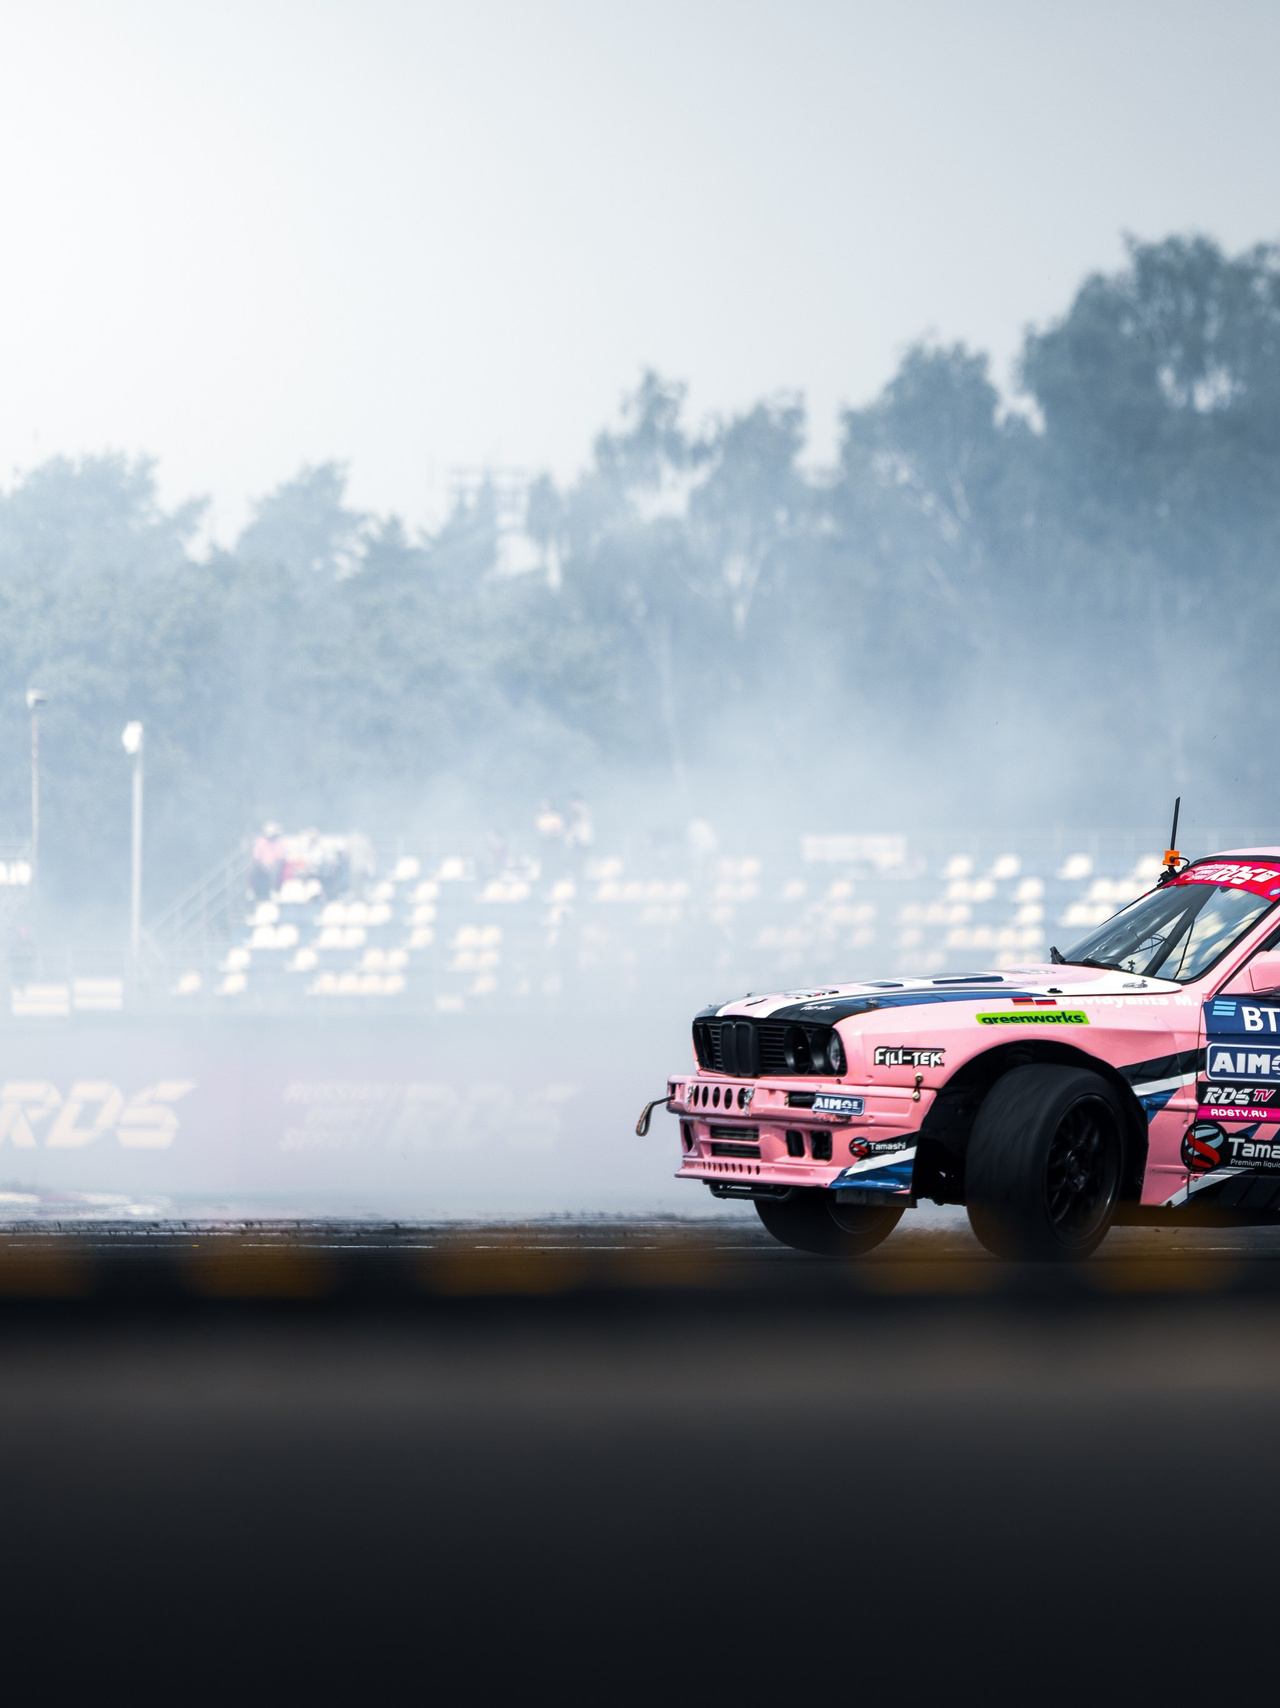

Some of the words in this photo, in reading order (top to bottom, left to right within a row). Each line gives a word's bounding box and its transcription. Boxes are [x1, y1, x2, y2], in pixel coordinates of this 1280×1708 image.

[981, 1011, 1084, 1025] greenworks
[874, 1048, 944, 1068] FILI-TEK
[1202, 1087, 1254, 1105] RDS
[1252, 1089, 1277, 1103] TV
[814, 1098, 861, 1110] AIMOL
[0, 1080, 198, 1149] RDS
[1210, 1108, 1268, 1118] RDSTV.RU
[868, 1142, 907, 1151] Tamashi
[1230, 1158, 1262, 1167] Premium
